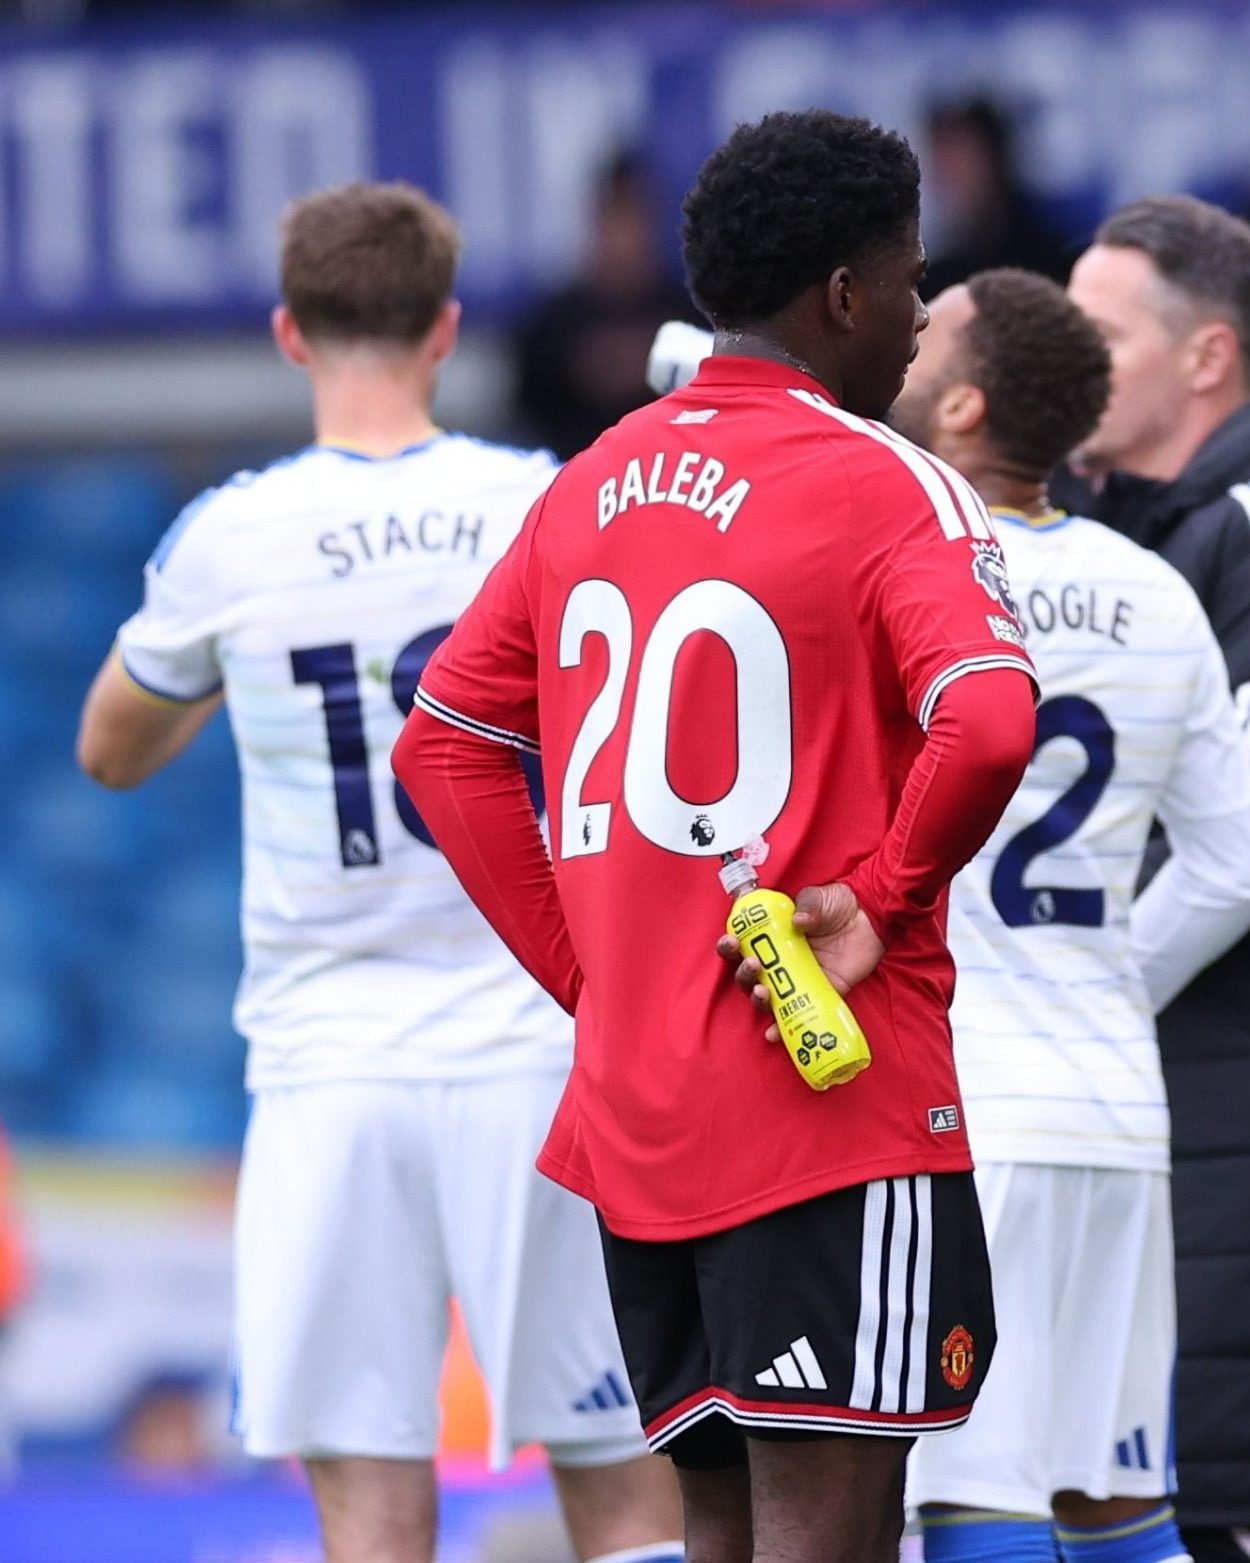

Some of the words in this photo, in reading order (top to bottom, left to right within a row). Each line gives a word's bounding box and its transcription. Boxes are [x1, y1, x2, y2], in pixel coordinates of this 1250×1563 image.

[0, 50, 375, 302] TED
[598, 452, 751, 532] BALEBA
[317, 512, 484, 578] STACH
[1014, 583, 1134, 646] OGLE
[558, 578, 794, 860] 20
[992, 695, 1115, 930] 2
[751, 934, 796, 1000] GO
[778, 993, 810, 1020] ENERGY
